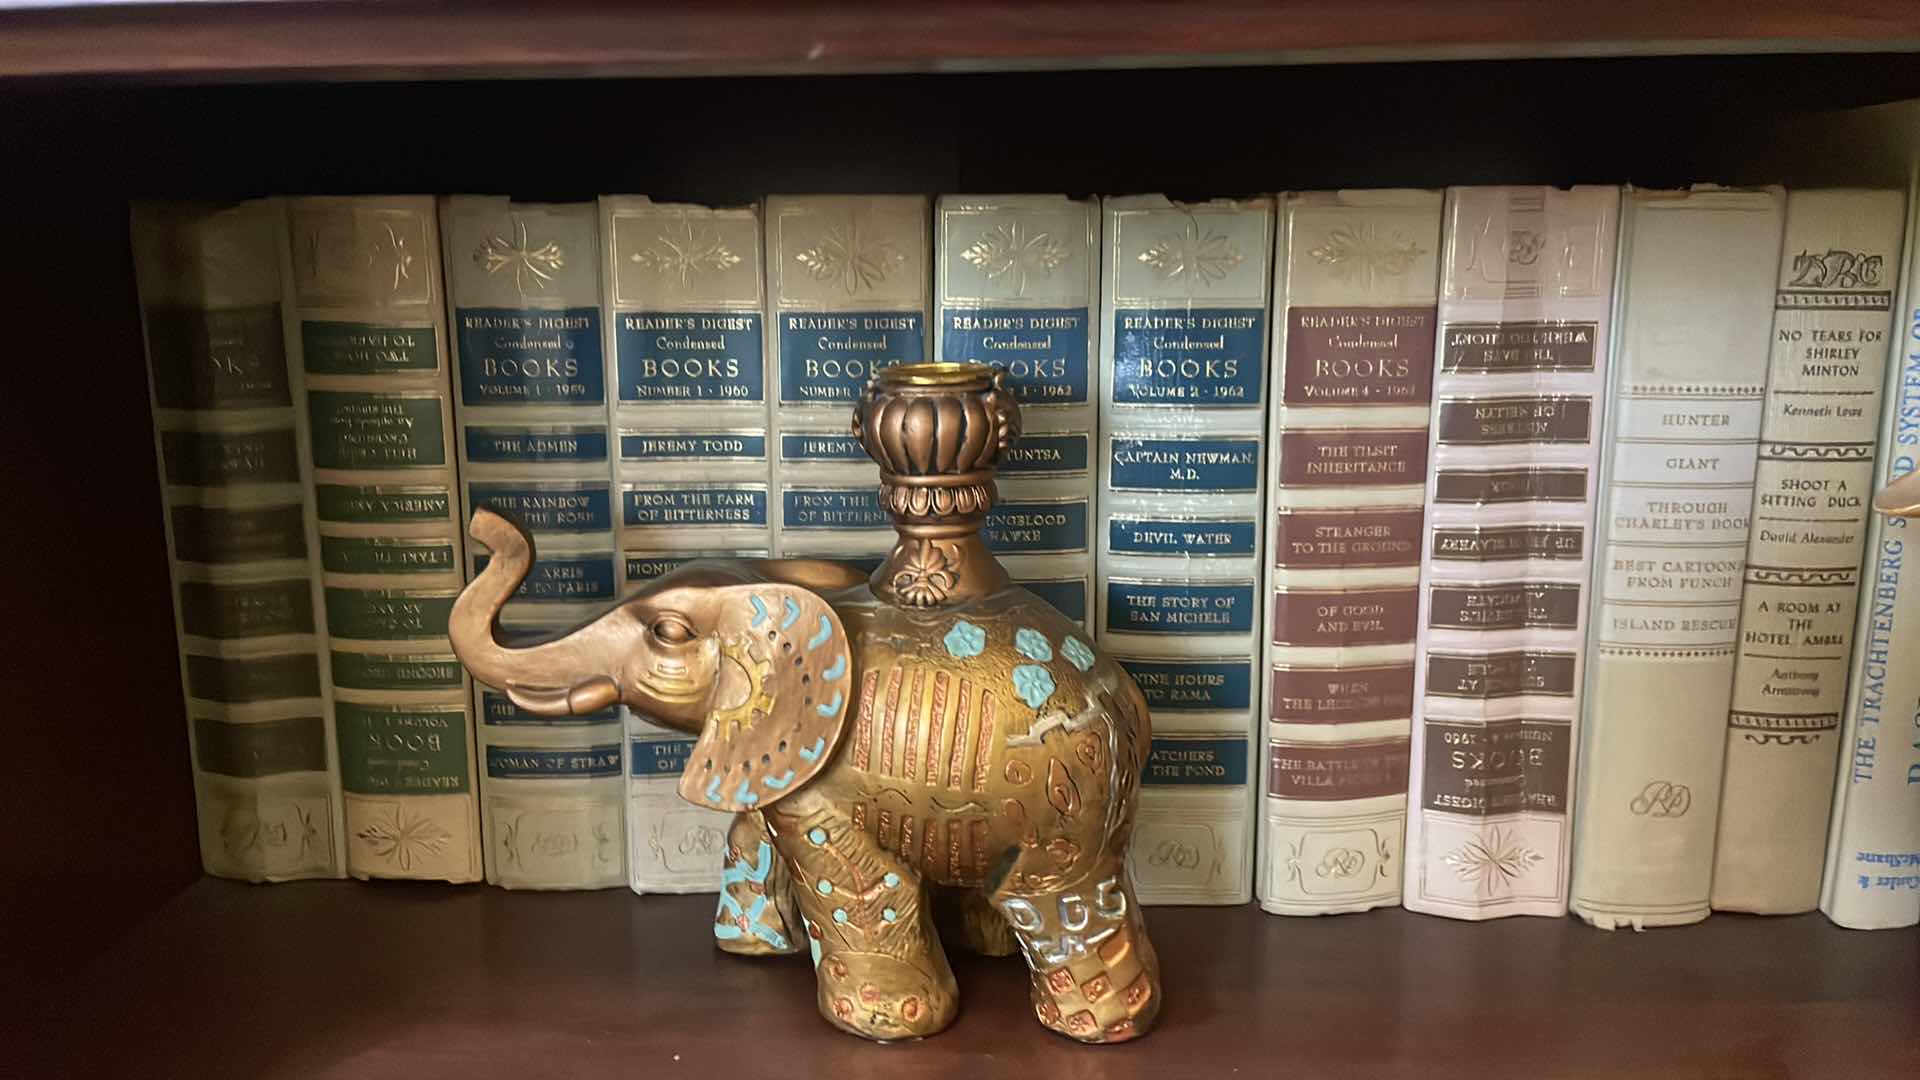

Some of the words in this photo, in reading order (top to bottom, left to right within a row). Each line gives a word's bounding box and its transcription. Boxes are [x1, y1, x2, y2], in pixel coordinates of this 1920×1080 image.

[465, 317, 532, 329] READER'S
[625, 317, 696, 330] READER'S
[702, 317, 753, 330] DIGEST
[789, 317, 857, 330] READER'S
[864, 317, 916, 330] DIGEST
[953, 317, 1024, 330] READER'S
[1030, 317, 1079, 330] DIGEST
[1124, 317, 1196, 330] READER'S
[1202, 317, 1256, 329] DIGEST
[1301, 316, 1370, 329] READER'S
[656, 335, 725, 350] Condensed
[983, 335, 1052, 350] Condensed
[1153, 334, 1224, 350] Condensed
[1328, 333, 1399, 349] Condensed
[1778, 329, 1803, 342] NO
[1812, 329, 1853, 343] TEARS
[1859, 329, 1883, 343] FOR
[818, 336, 887, 351] Condensed
[1805, 347, 1861, 361] SHIRLEY
[484, 358, 578, 377] BOOKS
[642, 358, 739, 378] BOOKS
[1139, 358, 1238, 378] BOOKS
[1316, 358, 1410, 378] BOOKS
[1801, 364, 1861, 377] MINTON
[636, 385, 690, 397] NUMBER
[720, 385, 749, 397] 1960
[800, 385, 851, 397] NUMBER
[1043, 385, 1073, 397] 1962
[1128, 384, 1185, 398] VOLUME
[1304, 385, 1358, 397] VOLUME
[1897, 354, 1920, 446] SYSTEM
[1784, 404, 1832, 417] Kenneth
[1662, 413, 1730, 426] HUNTER
[642, 440, 697, 454] JEREMY
[703, 440, 744, 452] TODD
[803, 440, 856, 454] JEREMY
[1318, 446, 1347, 458] THE
[1114, 451, 1179, 465] CAPTAIN
[1666, 458, 1720, 471] GIANT
[1169, 468, 1200, 480] M.D.
[1306, 461, 1406, 474] INHERITANCE
[1781, 478, 1831, 491] SHOOT
[1837, 479, 1848, 491] A
[522, 496, 590, 508] RAINBOW
[634, 493, 676, 506] FROM
[681, 493, 711, 505] THE
[717, 493, 755, 506] FARM
[794, 495, 833, 507] FROM
[840, 495, 869, 507] THE
[1760, 493, 1818, 508] SITTING
[1828, 496, 1862, 508] DUCK
[1647, 501, 1728, 514] THROUGH
[638, 510, 659, 521] OF
[664, 508, 750, 521] BITTERNESS
[799, 511, 817, 521] OF
[1134, 532, 1177, 544] DEVIL
[1183, 533, 1232, 545] WATER
[1315, 526, 1391, 538] STRANGER
[1760, 529, 1798, 544] David
[1292, 542, 1314, 553] TO
[1318, 542, 1346, 554] THE
[1614, 560, 1656, 571] BEST
[1626, 576, 1673, 588] FROM
[1680, 576, 1732, 589] PUNCH
[1126, 595, 1156, 608] THE
[1161, 596, 1209, 608] STORY
[1215, 596, 1235, 608] OF
[1758, 600, 1769, 612] A
[1777, 602, 1820, 614] ROOM
[1826, 602, 1841, 614] AT
[1130, 610, 1160, 622] SAN
[1166, 611, 1231, 623] MICHELE
[1316, 606, 1339, 617] OF
[1316, 621, 1348, 632] AND
[1352, 620, 1385, 632] EVIL
[1613, 618, 1676, 631] ISLAND
[1680, 618, 1738, 631] RESCUE
[1789, 618, 1813, 631] THE
[1745, 631, 1791, 646] HOTEL
[1861, 539, 1904, 727] TRACHTENBERG
[1175, 674, 1225, 686] HOURS
[1144, 689, 1165, 700] TO
[1170, 689, 1212, 700] RAMA
[1282, 698, 1312, 709] THE
[1443, 732, 1477, 745] 1960
[1272, 757, 1302, 769] THE
[1854, 736, 1877, 785] THE
[1151, 766, 1180, 777] THE
[1185, 766, 1226, 777] POND
[1291, 775, 1334, 786] VILLA
